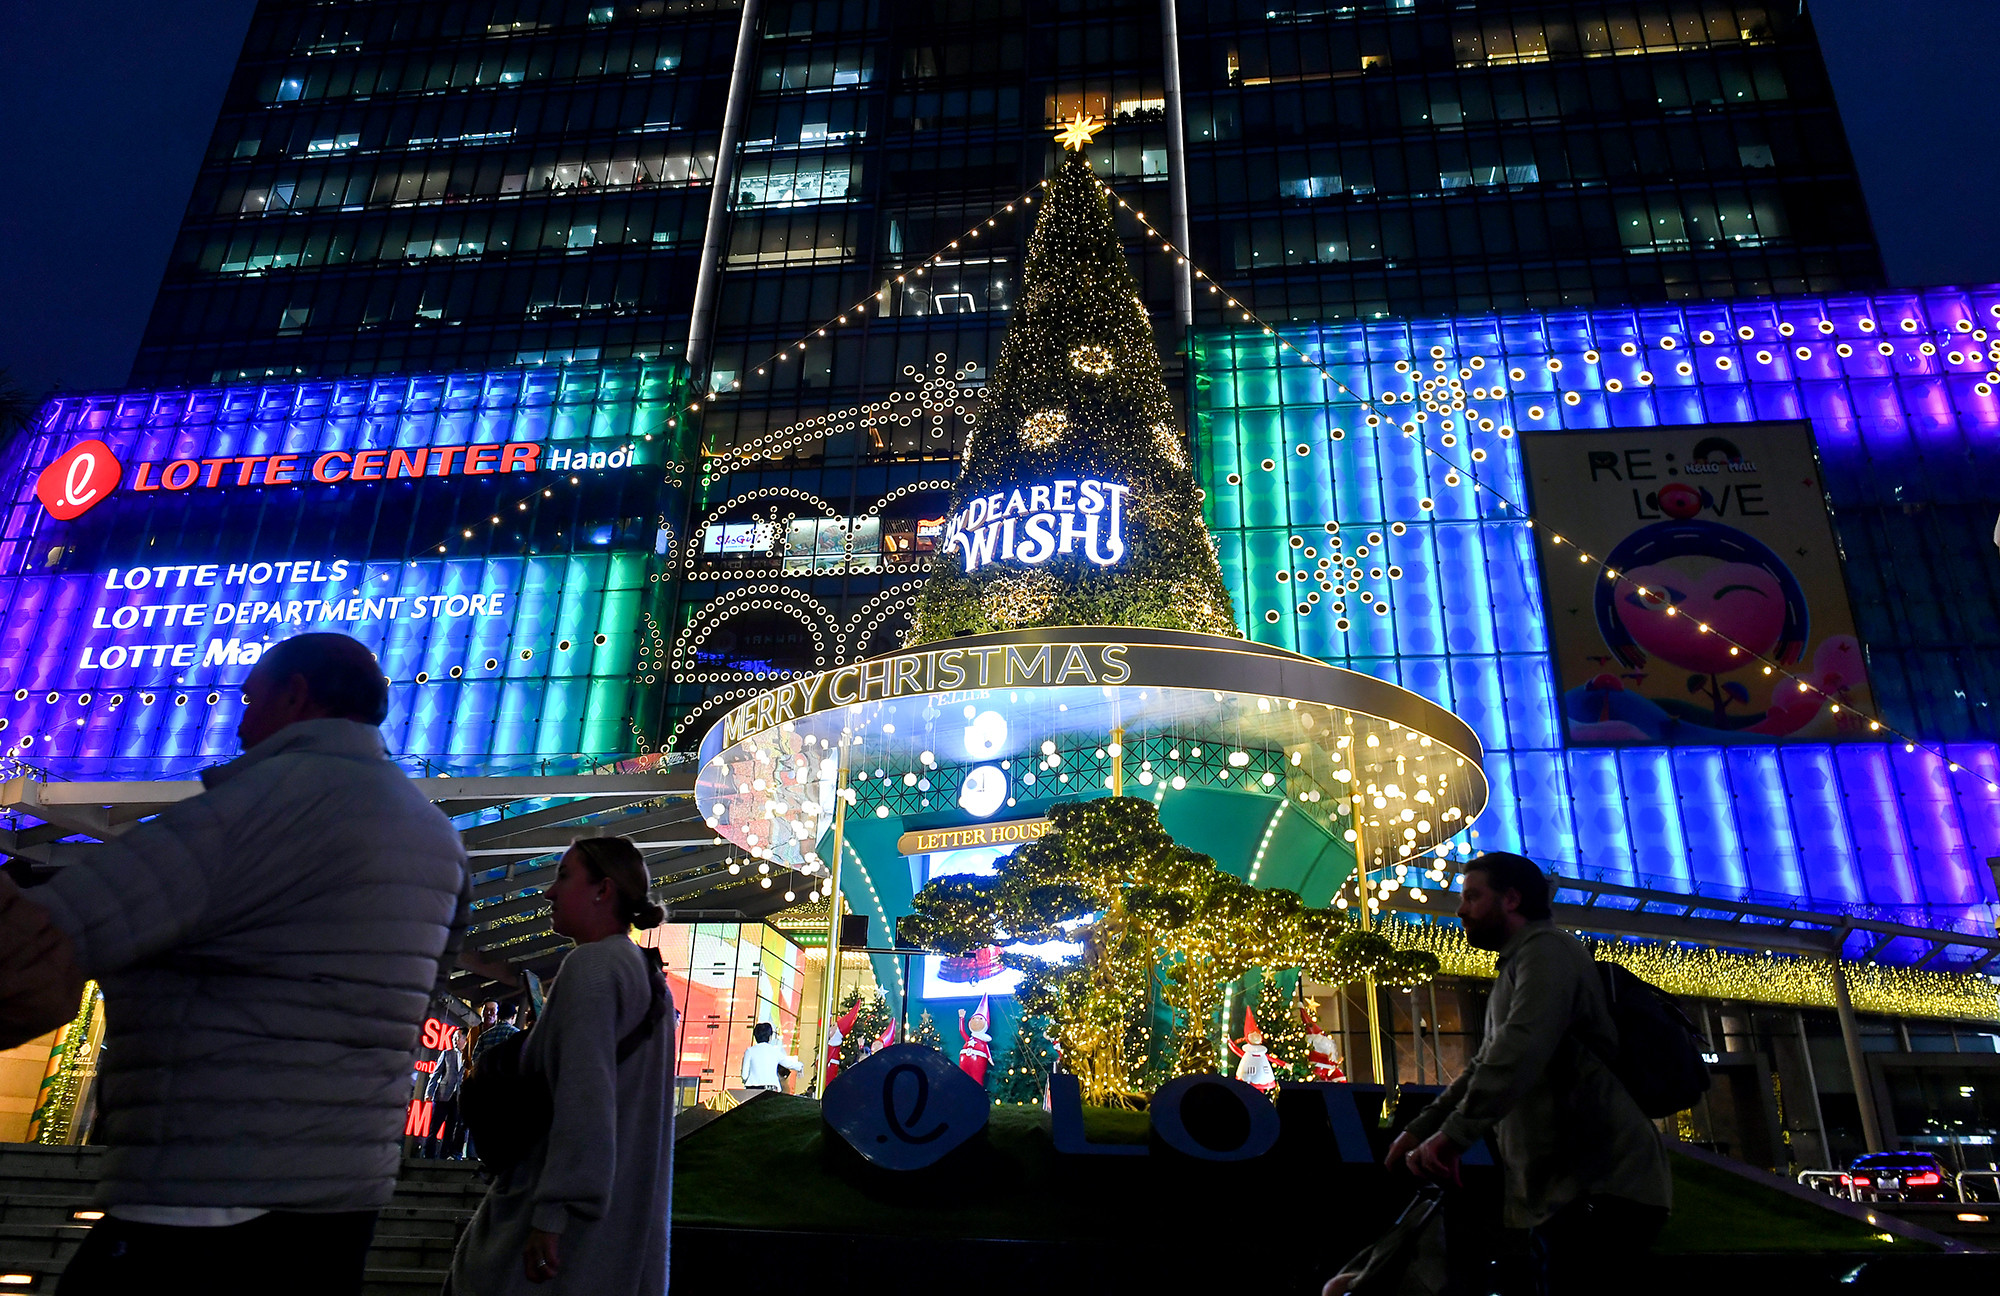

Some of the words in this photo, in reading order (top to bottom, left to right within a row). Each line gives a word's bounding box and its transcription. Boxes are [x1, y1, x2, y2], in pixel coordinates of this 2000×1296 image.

[134, 454, 298, 491] LOTTE
[312, 442, 541, 483] CENTER
[550, 443, 635, 471] Hanoi
[968, 479, 1130, 546] DEAREST
[950, 512, 1124, 573] WISH
[104, 564, 219, 590] LOTTE
[225, 560, 349, 586] HOTELS
[92, 603, 208, 630] LOTTE
[214, 597, 405, 625] DEPARTMENT
[410, 593, 505, 619] STORE
[79, 643, 197, 670] LOTTE
[722, 670, 824, 752] MERRY
[829, 644, 1133, 706] CHRISTMAS
[917, 829, 987, 850] LETTER
